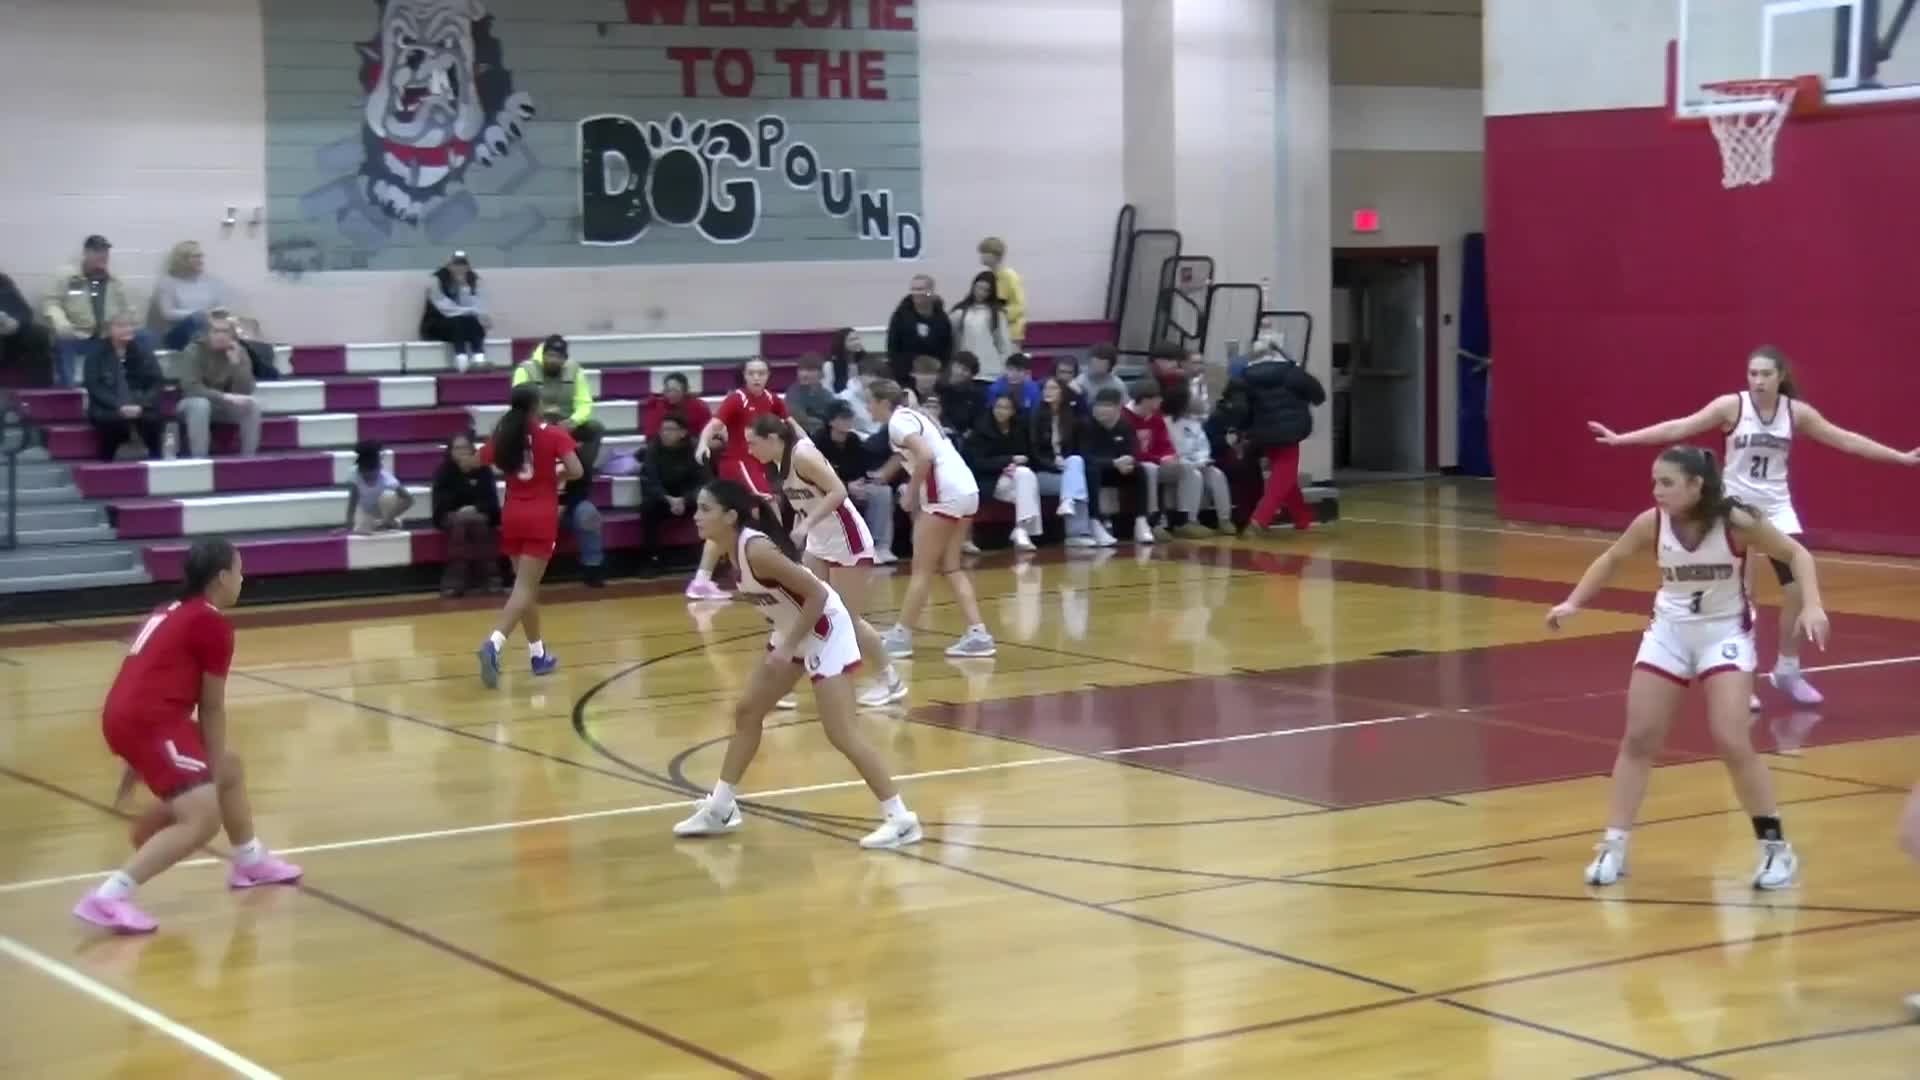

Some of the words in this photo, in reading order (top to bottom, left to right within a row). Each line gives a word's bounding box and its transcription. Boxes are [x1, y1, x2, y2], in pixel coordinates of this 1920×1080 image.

[667, 47, 755, 98] TO
[775, 49, 888, 100] THE
[578, 113, 761, 245] DOG
[756, 115, 922, 261] POUND
[1750, 455, 1769, 479] 21
